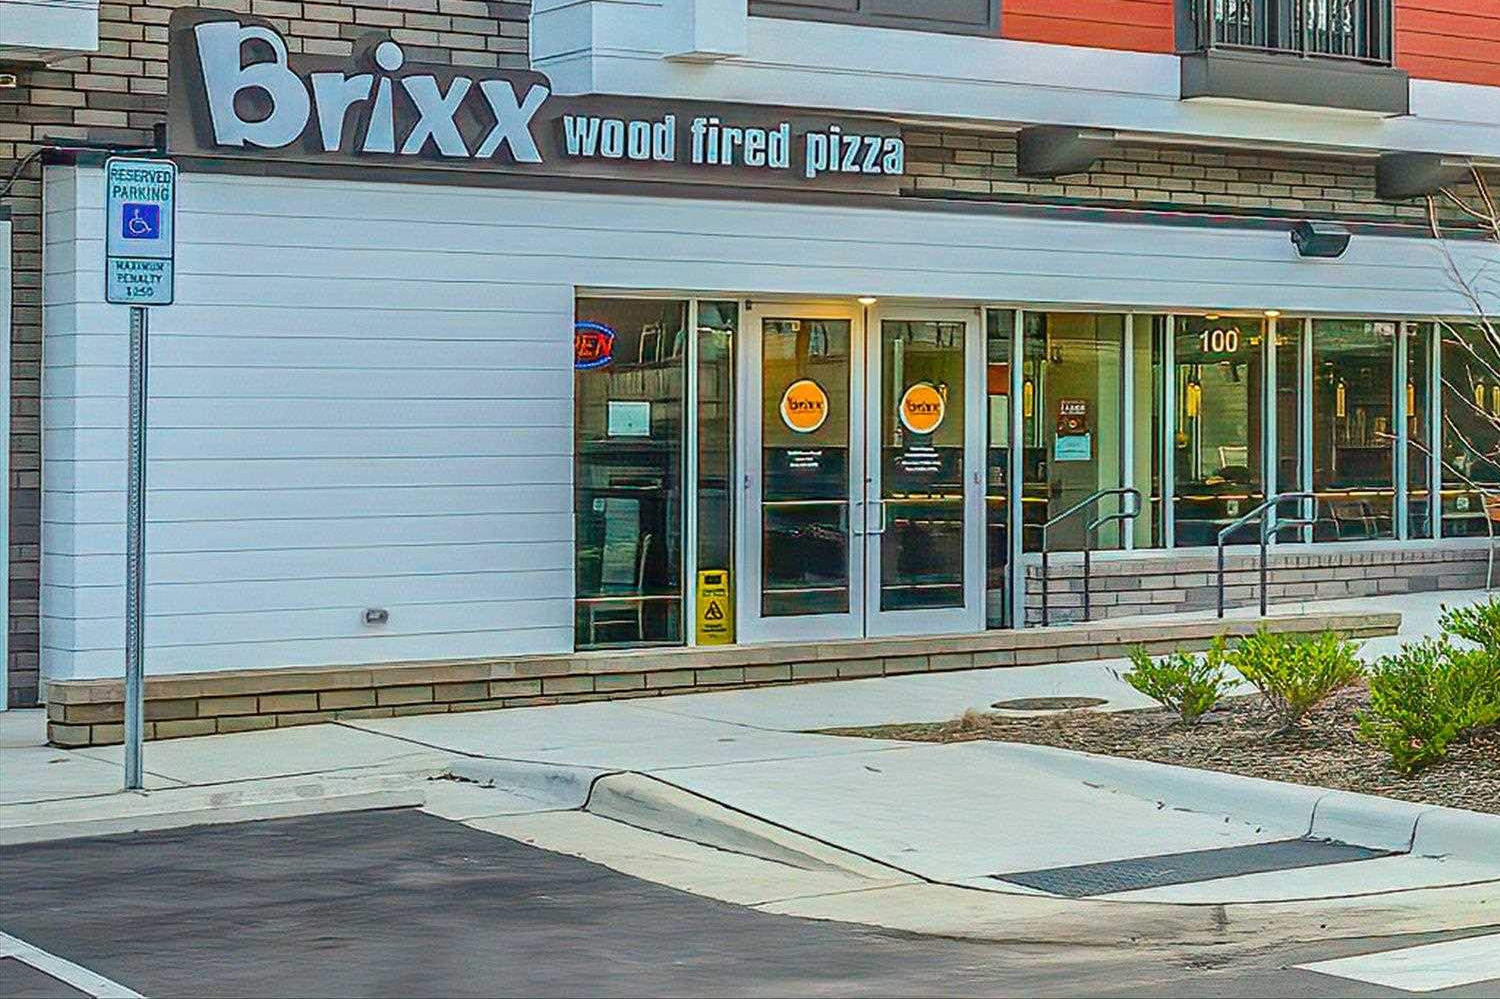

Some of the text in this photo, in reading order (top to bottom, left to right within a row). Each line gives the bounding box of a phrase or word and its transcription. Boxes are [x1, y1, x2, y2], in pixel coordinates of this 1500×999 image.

[194, 21, 550, 163] Brixx
[563, 114, 905, 178] wood fired pizza
[110, 168, 171, 184] RESERVED
[112, 185, 170, 201] PARKING
[117, 272, 163, 284] PENALTY
[1200, 329, 1239, 352] 100
